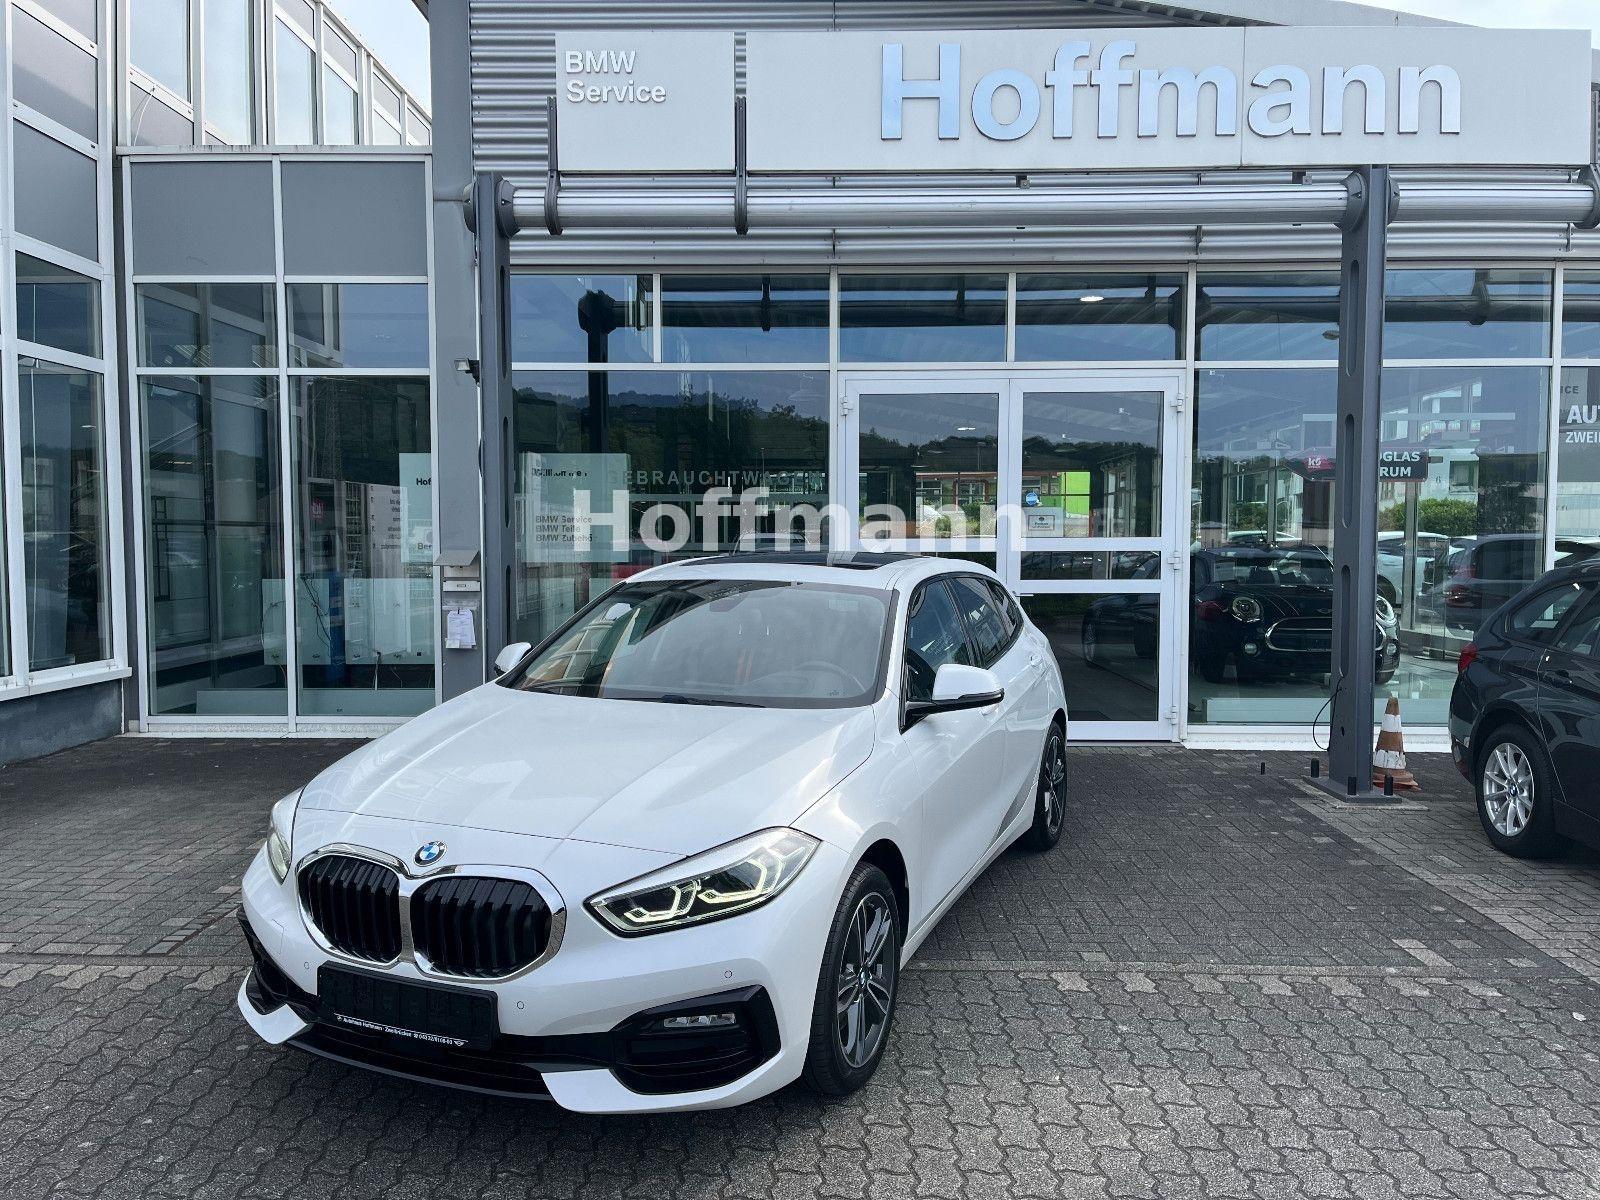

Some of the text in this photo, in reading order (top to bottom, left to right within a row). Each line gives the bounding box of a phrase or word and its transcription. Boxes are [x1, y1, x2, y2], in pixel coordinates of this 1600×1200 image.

[564, 50, 637, 75] BMW
[566, 79, 667, 104] Service
[881, 40, 1462, 141] Hoffmann
[1566, 404, 1600, 424] AU
[535, 515, 593, 524] BMW Service
[535, 525, 559, 533] BMW
[561, 534, 597, 542] Zubehö
